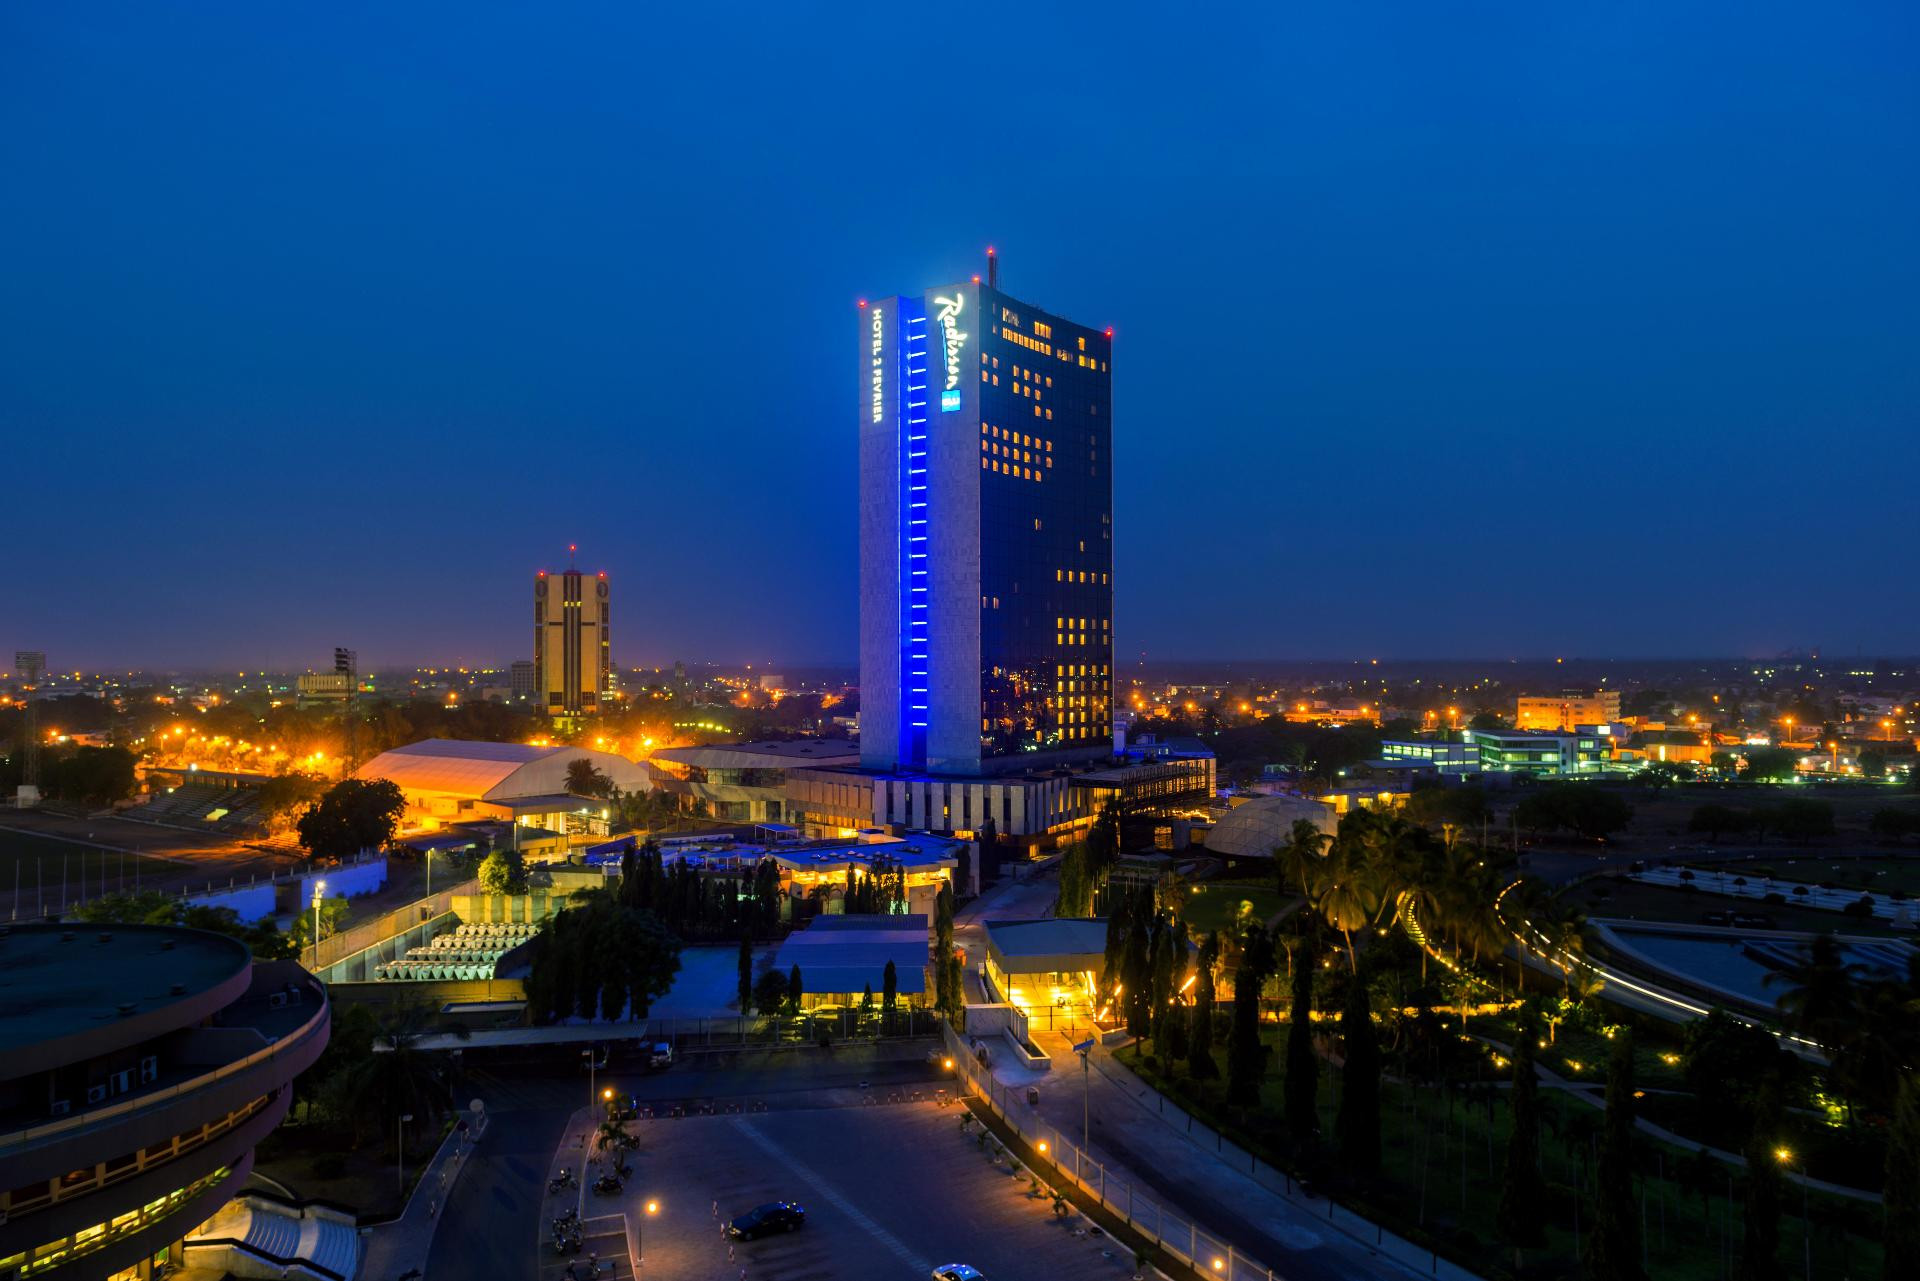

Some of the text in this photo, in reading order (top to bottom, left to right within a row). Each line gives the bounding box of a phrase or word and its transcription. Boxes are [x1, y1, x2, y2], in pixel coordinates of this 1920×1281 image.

[872, 308, 883, 423] HOTEL 2 FEVRIER
[934, 293, 968, 390] Radisson
